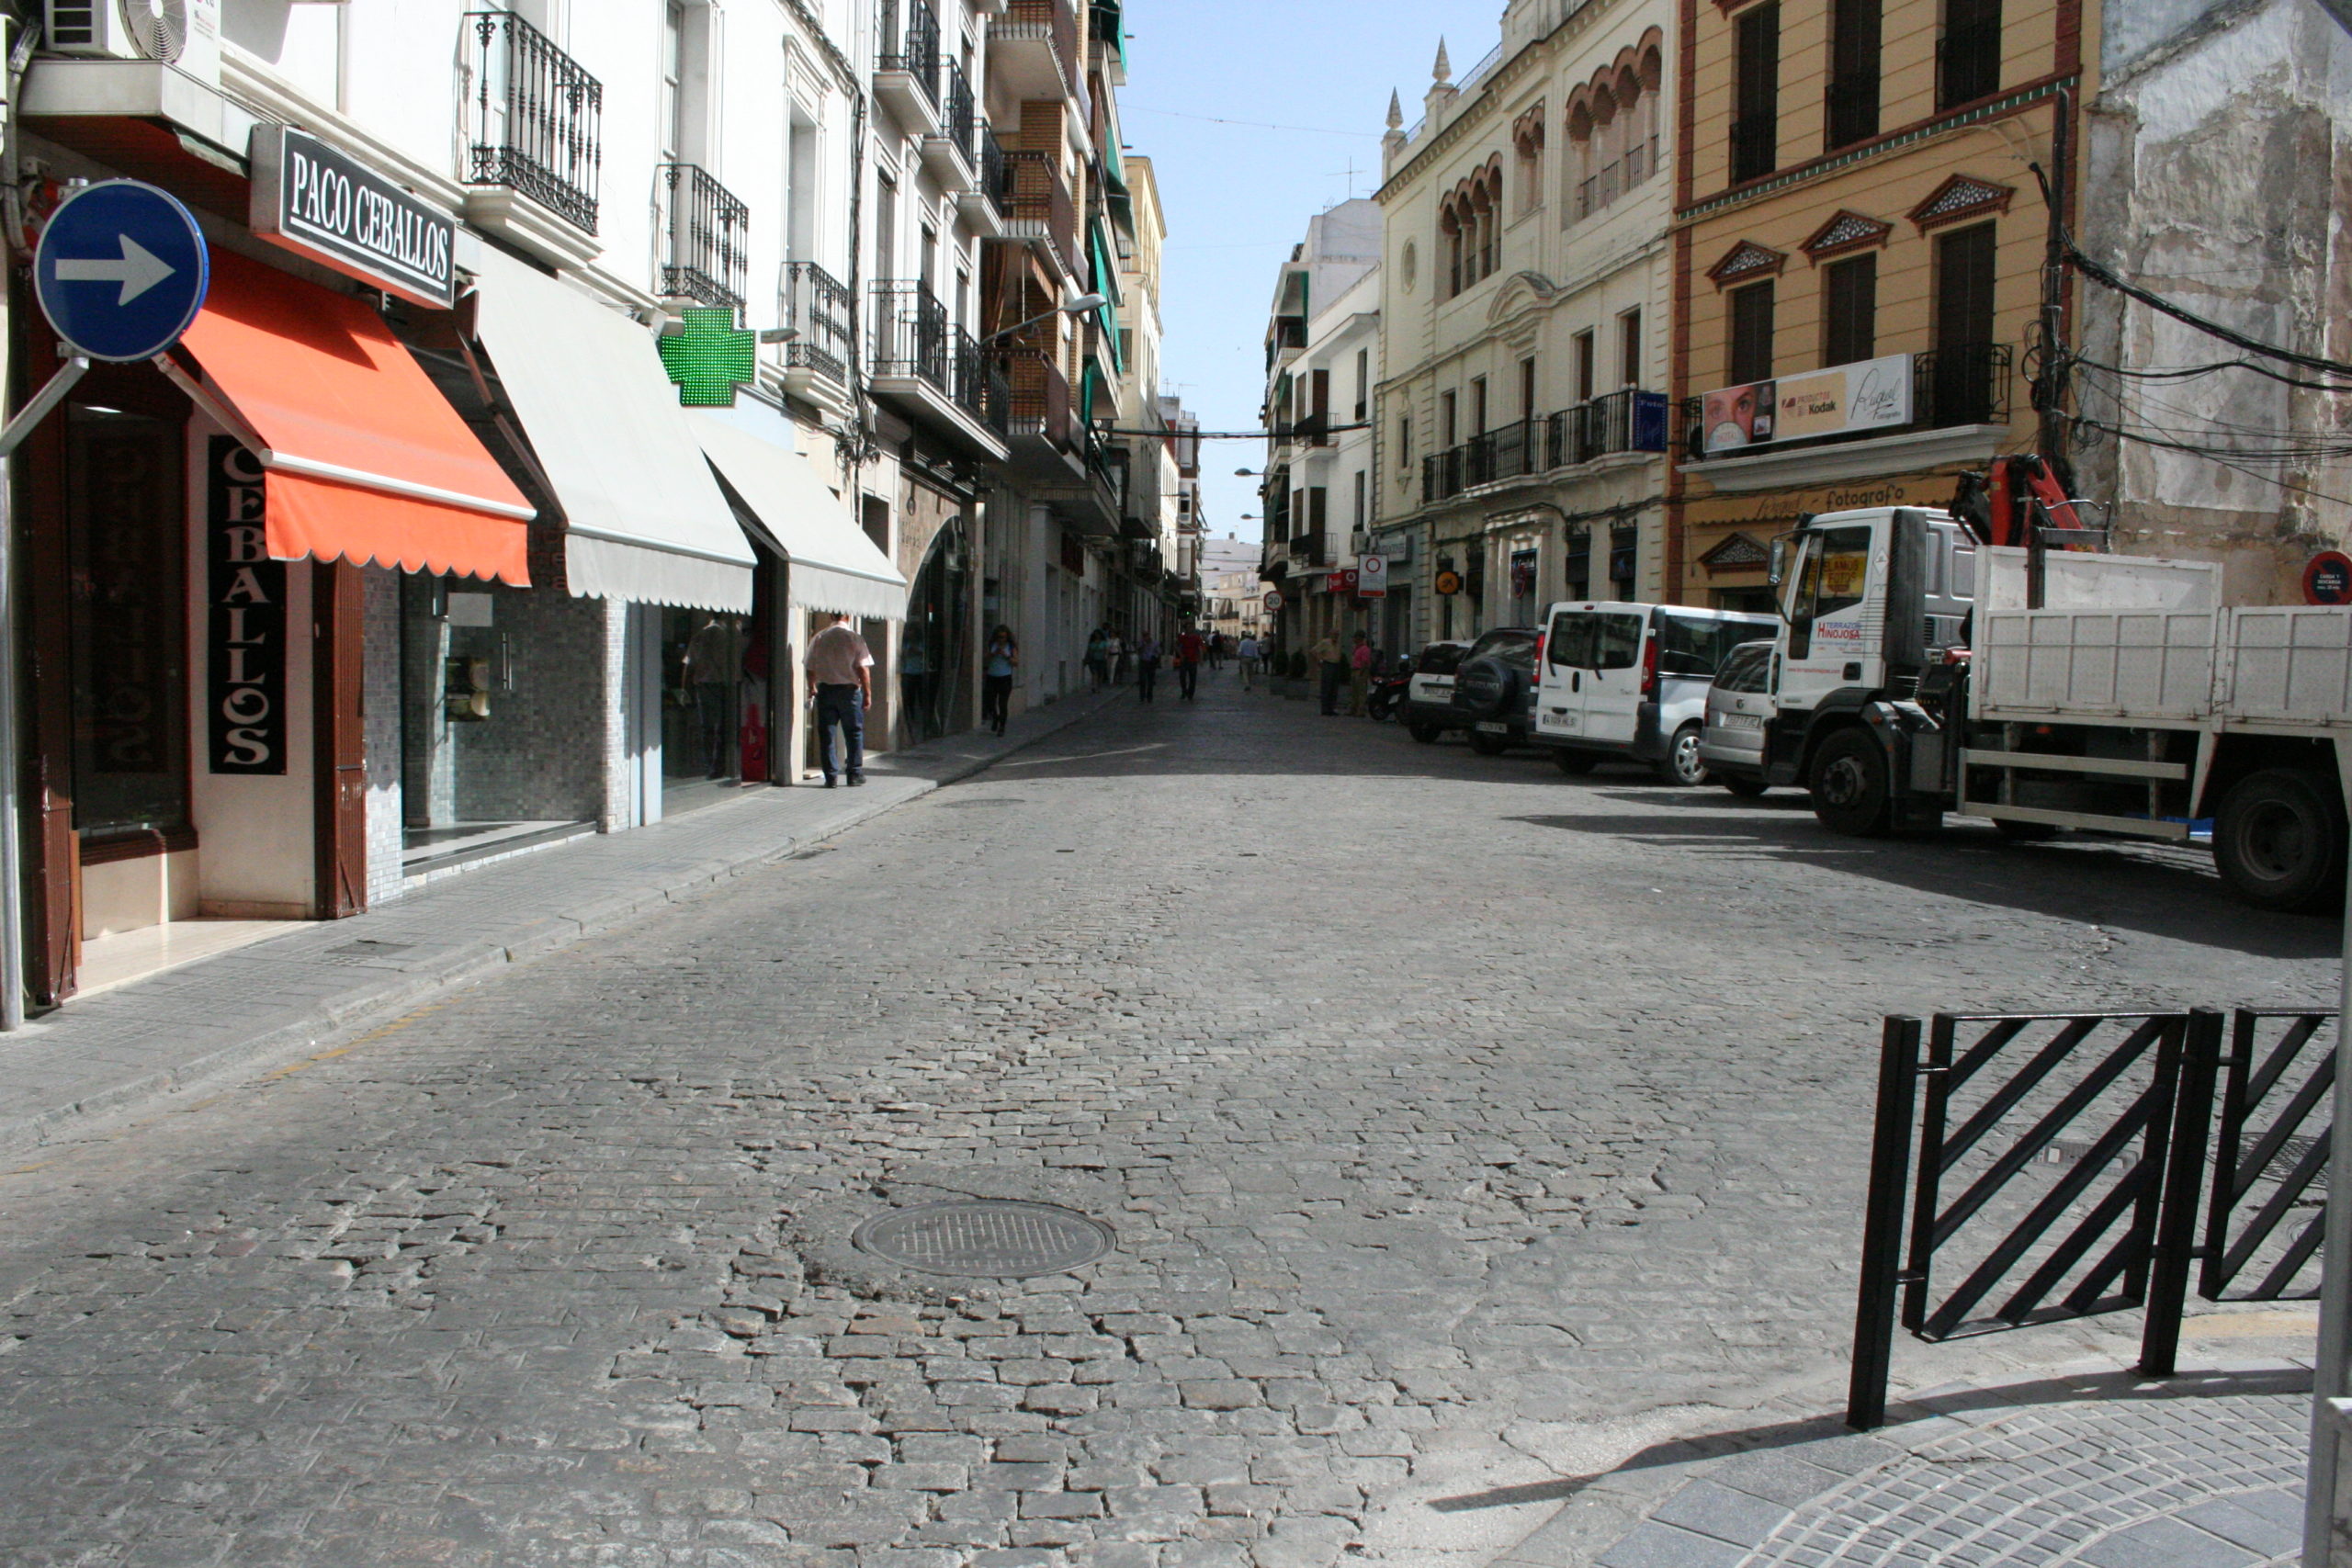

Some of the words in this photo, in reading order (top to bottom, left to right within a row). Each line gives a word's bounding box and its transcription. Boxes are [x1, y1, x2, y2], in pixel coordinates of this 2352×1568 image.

[291, 151, 351, 236] PACO
[356, 186, 448, 281] CEBALLOS
[1808, 400, 1837, 415] Kodak
[1826, 483, 1905, 511] fotografo
[221, 446, 271, 766] CEBALLOS
[1817, 622, 1860, 639] HINOJOSA
[1466, 680, 1500, 691] SUZUKI
